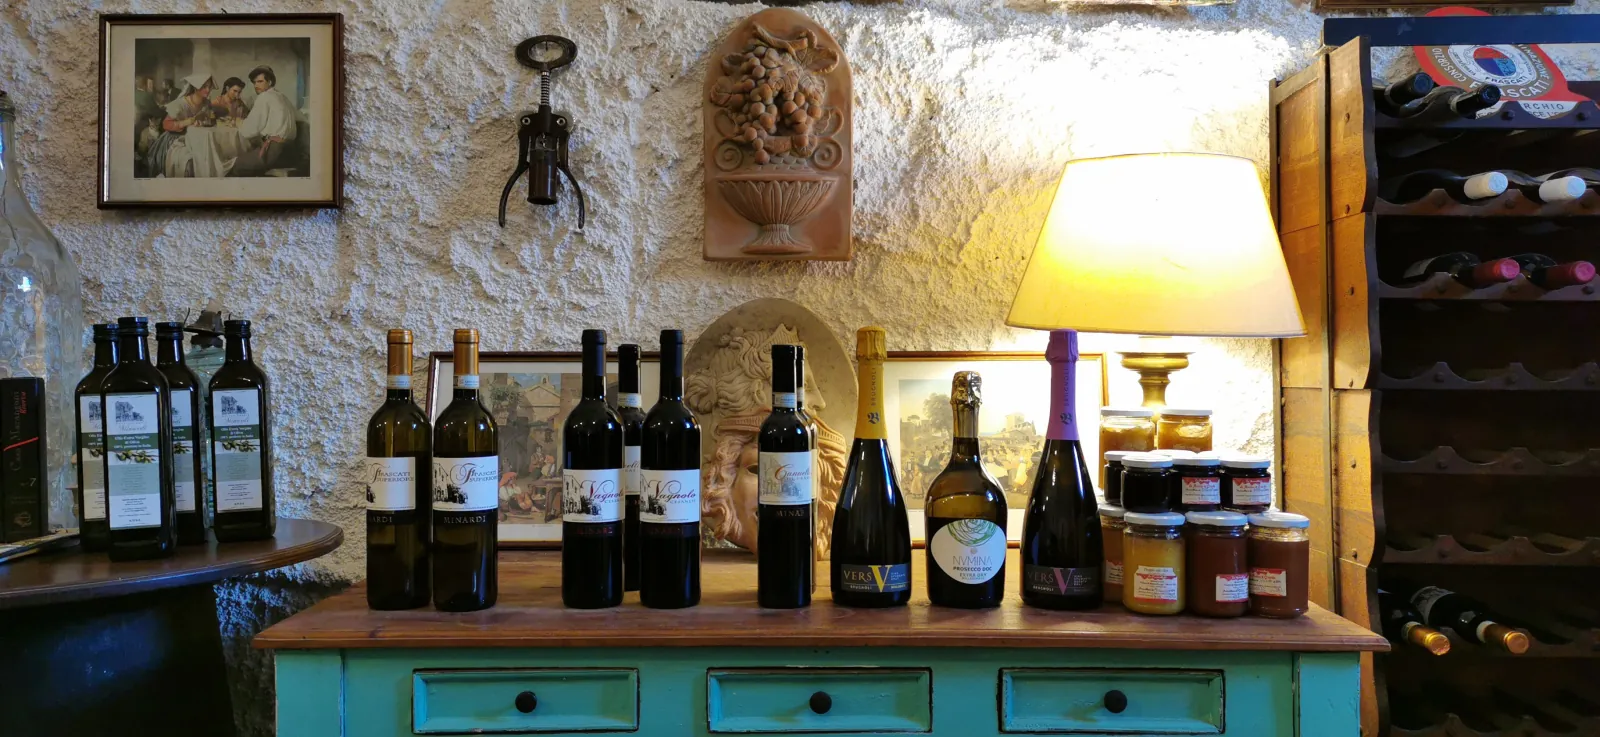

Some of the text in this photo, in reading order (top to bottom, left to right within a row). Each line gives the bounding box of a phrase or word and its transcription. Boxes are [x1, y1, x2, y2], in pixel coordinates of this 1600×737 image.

[1432, 47, 1467, 82] CONSORZIO
[1518, 44, 1550, 80] INAZIONE
[1485, 76, 1527, 85] FRASCATI
[1469, 80, 1550, 98] FASCATI
[1523, 102, 1564, 110] RCHIO
[647, 480, 696, 503] Vagnolo
[443, 515, 486, 524] MINARDI
[843, 570, 872, 582] VERS
[1027, 572, 1054, 584] VERS
